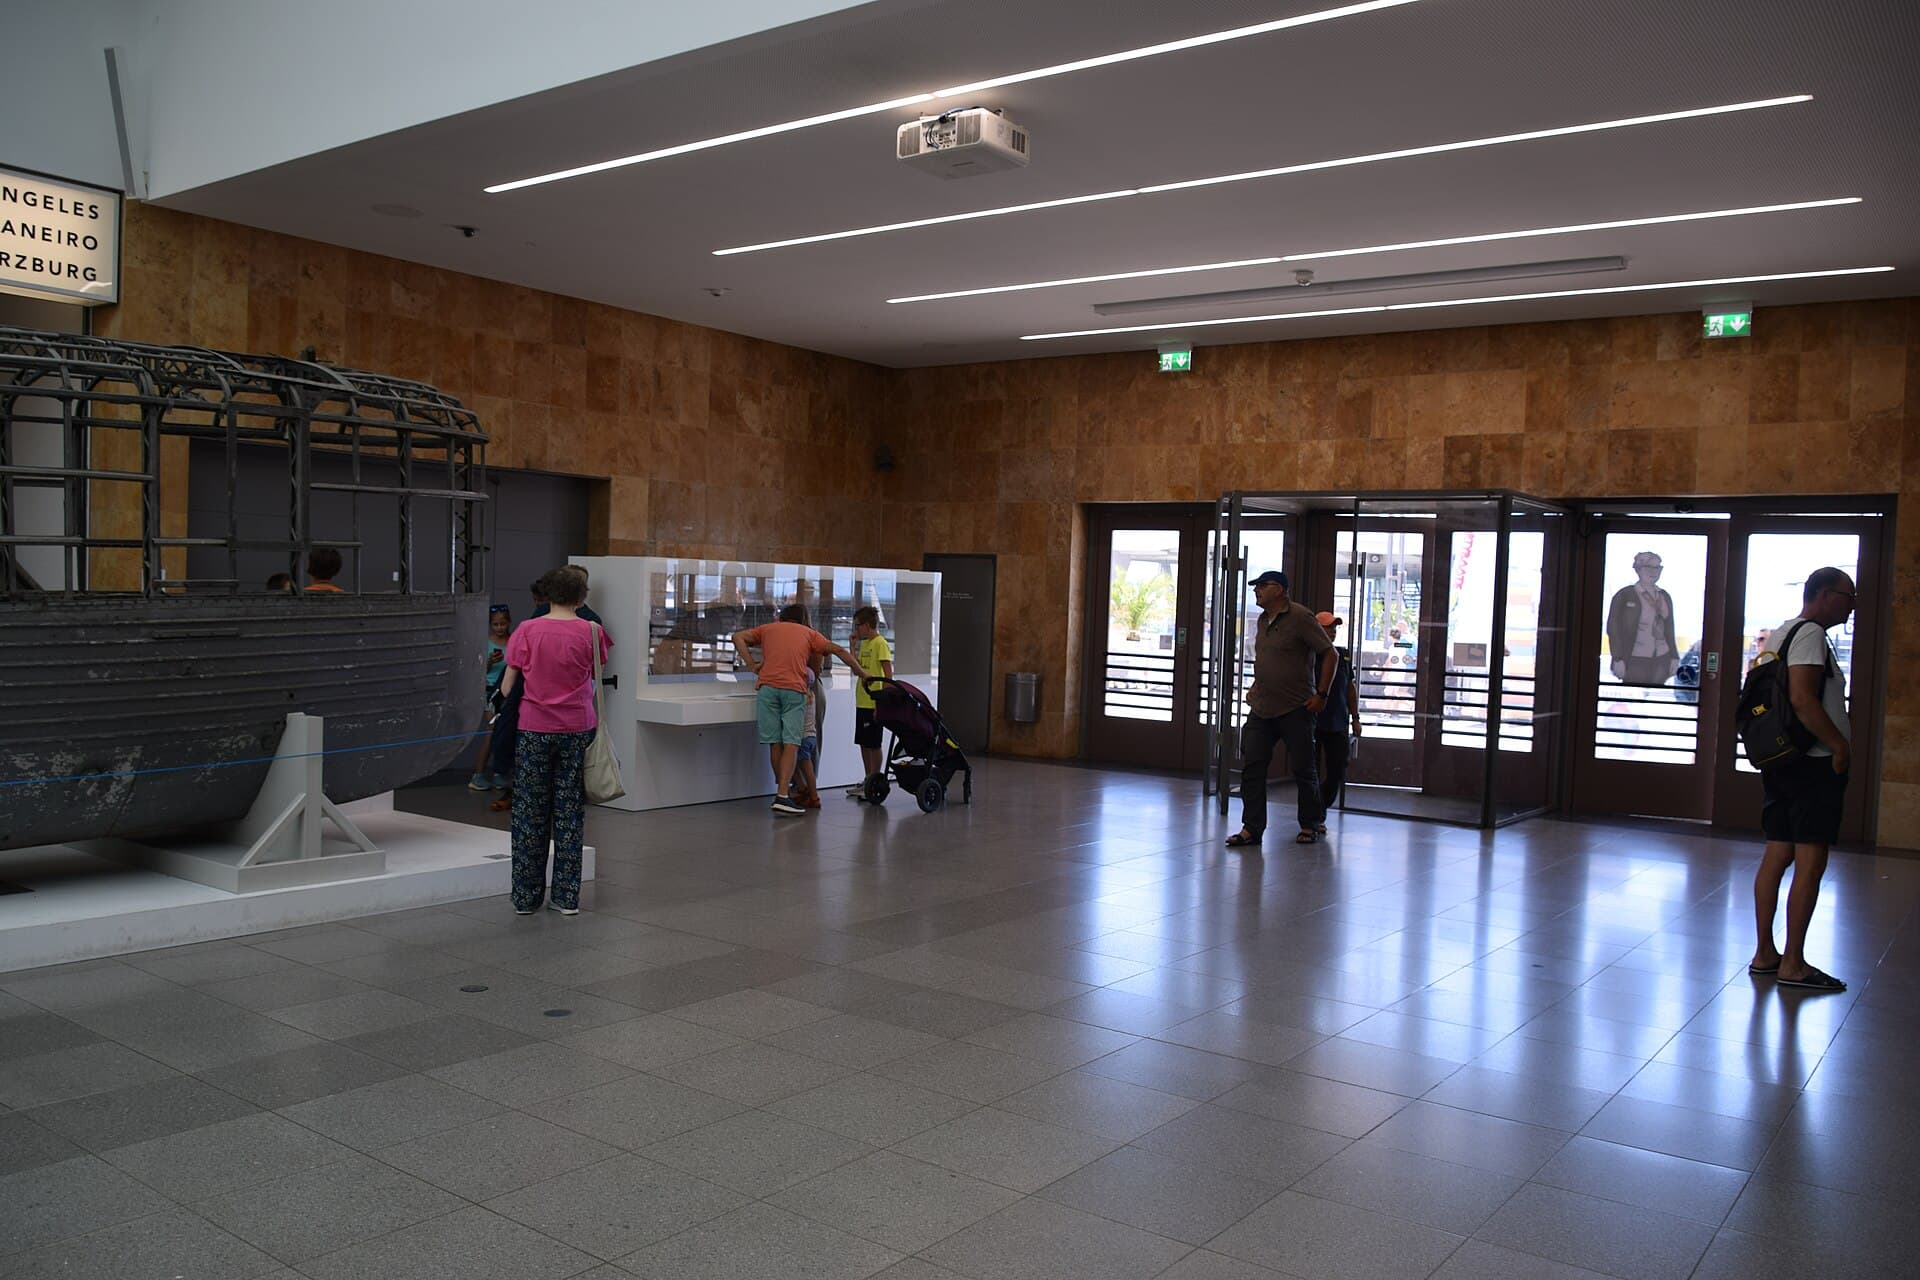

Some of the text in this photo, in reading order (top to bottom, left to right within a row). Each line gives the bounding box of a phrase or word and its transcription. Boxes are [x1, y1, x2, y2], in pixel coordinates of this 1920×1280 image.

[2, 186, 99, 220] NGELES
[1, 219, 98, 250] ANEIRO
[0, 251, 97, 282] RZBURG
